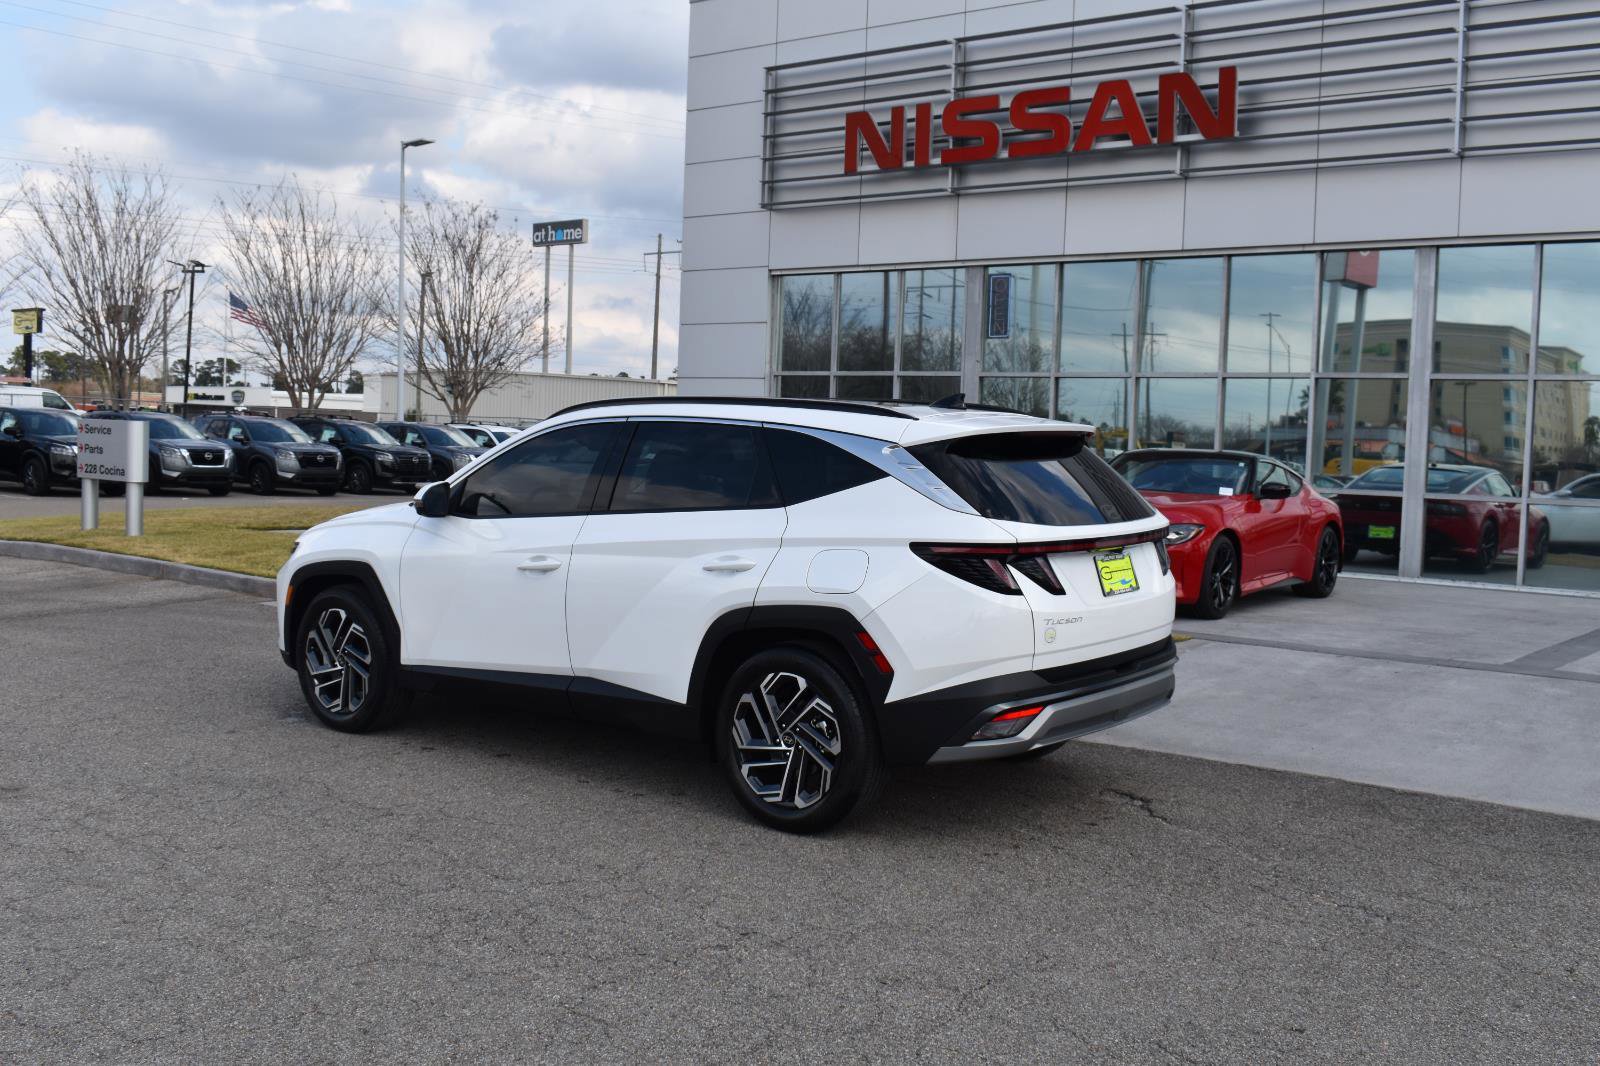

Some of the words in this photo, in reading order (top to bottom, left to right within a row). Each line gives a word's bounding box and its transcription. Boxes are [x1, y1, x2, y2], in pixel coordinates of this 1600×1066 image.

[844, 65, 1239, 176] NISSAN
[533, 229, 546, 243] at
[547, 225, 583, 241] home
[993, 278, 1008, 336] OPEN
[84, 424, 112, 435] Service
[84, 444, 104, 454] Parts
[84, 464, 98, 474] 228
[99, 465, 126, 476] Cocina
[1043, 616, 1084, 626] Tucson
